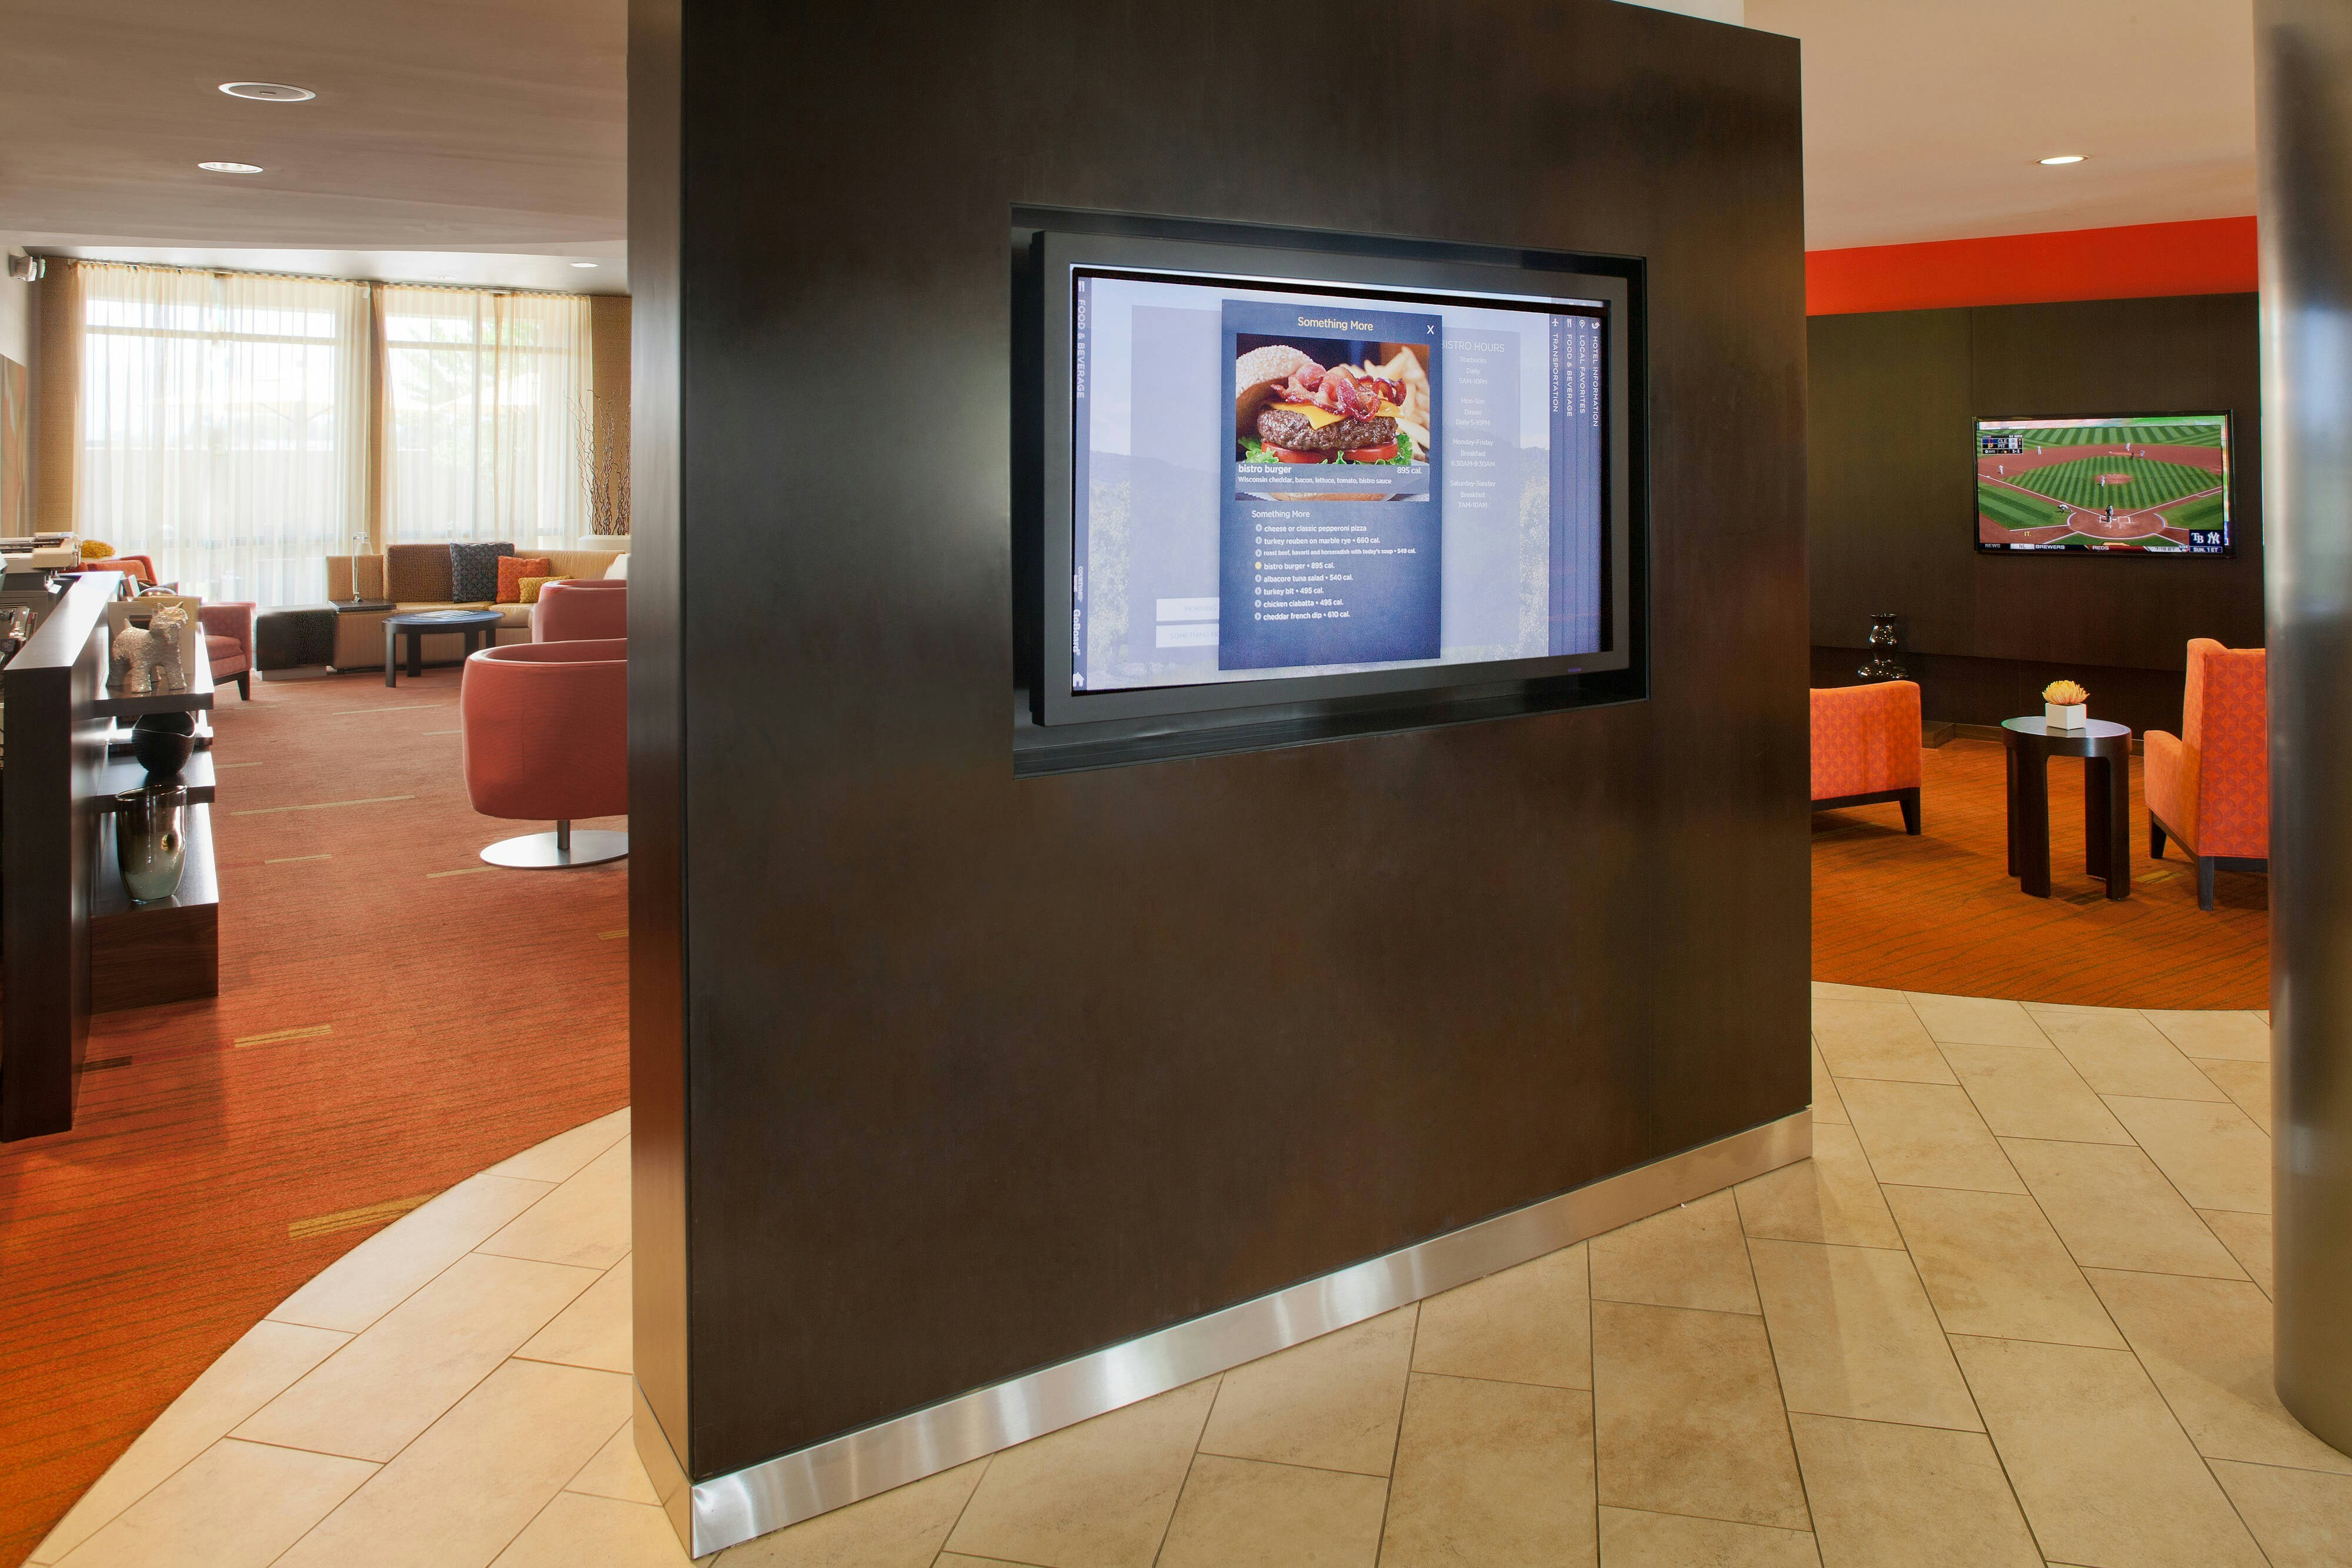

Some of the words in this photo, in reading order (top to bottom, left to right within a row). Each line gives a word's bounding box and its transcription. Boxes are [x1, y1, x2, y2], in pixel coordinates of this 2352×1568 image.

[1297, 316, 1348, 331] Something
[1350, 320, 1374, 331] More
[1474, 342, 1505, 352] HOURS
[1077, 343, 1085, 398] BEVERAGE
[1238, 464, 1262, 473] bistro
[1265, 464, 1292, 474] burger
[1251, 510, 1290, 519] Something
